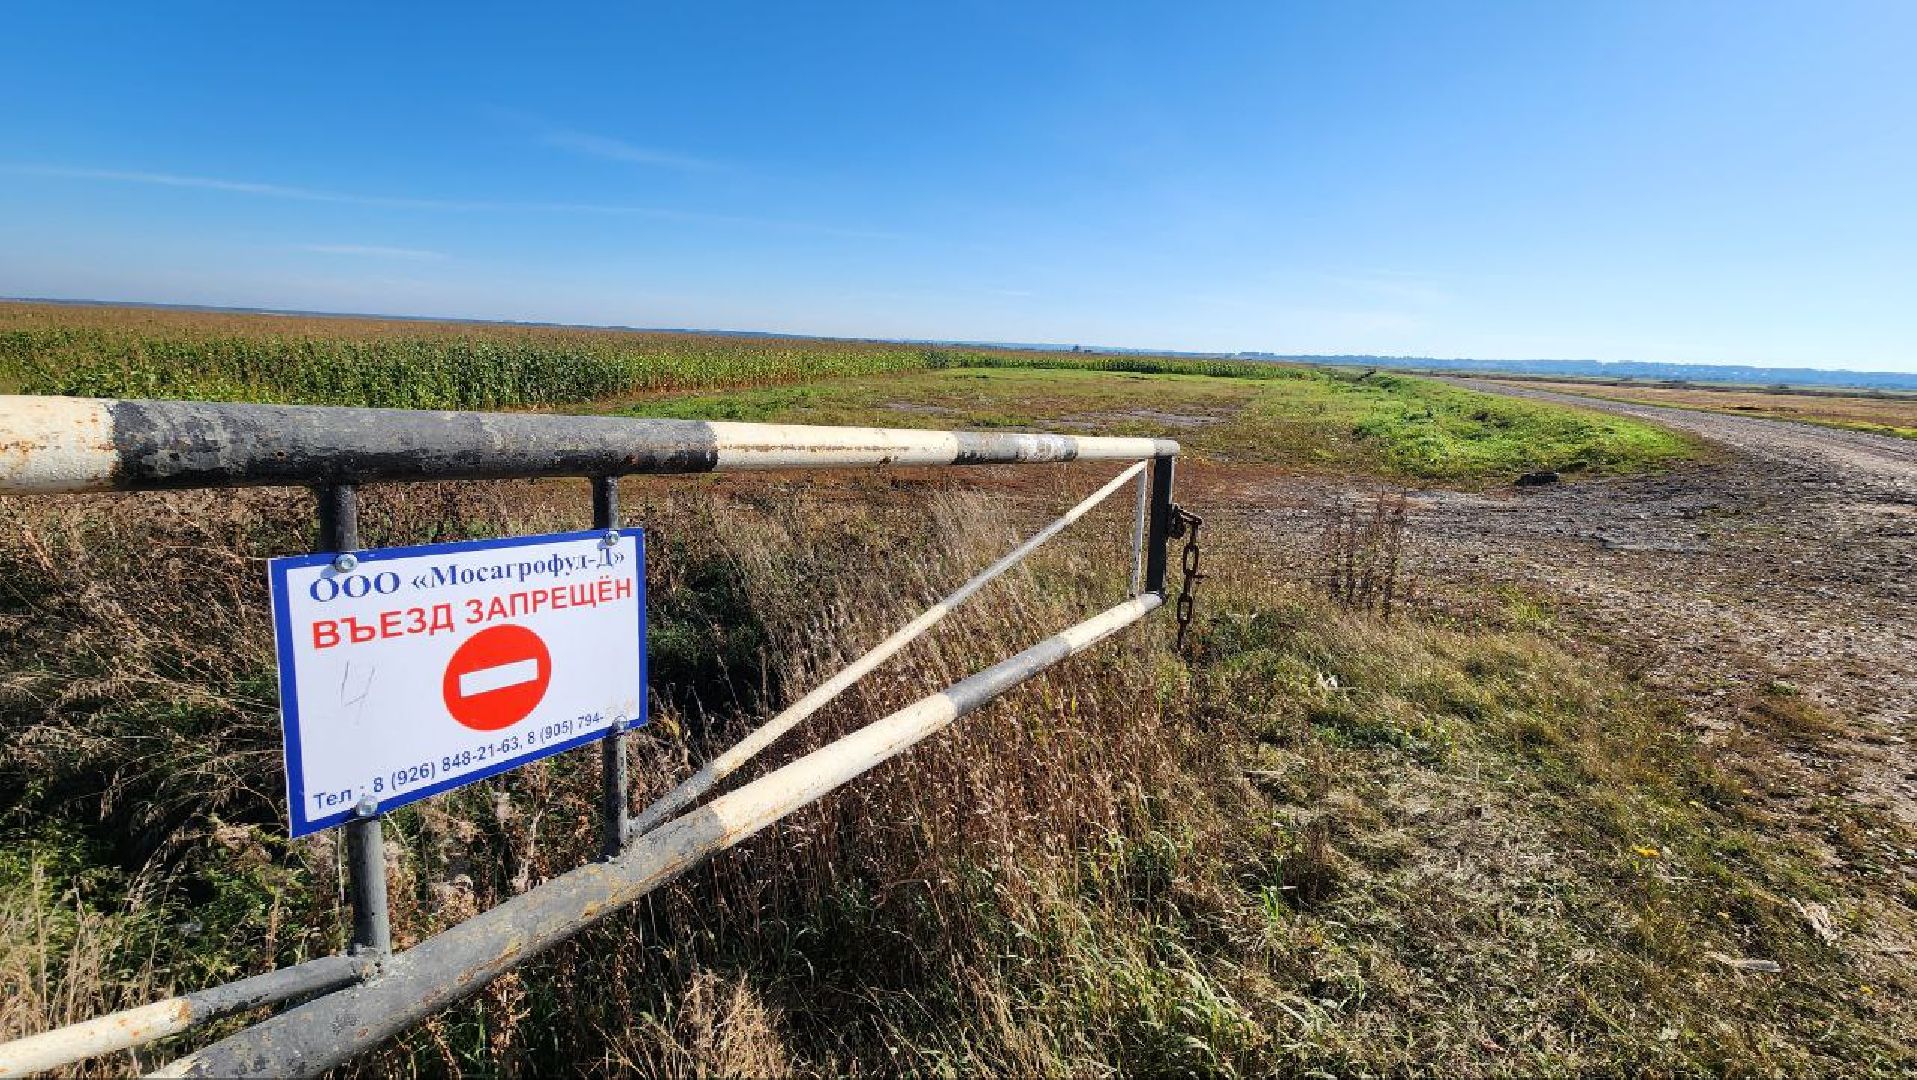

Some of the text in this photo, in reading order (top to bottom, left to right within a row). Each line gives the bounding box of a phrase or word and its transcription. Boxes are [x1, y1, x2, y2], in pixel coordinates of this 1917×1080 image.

[310, 547, 625, 602] ООО «Мосагрофуд-Д»
[312, 576, 632, 649] ВЪЕЗД ЗАПРЕЩЁН
[373, 776, 385, 793] 8
[391, 762, 436, 791] (926)
[442, 736, 523, 772] 848-21-63,
[527, 731, 536, 745] 8
[539, 719, 573, 744] (905)
